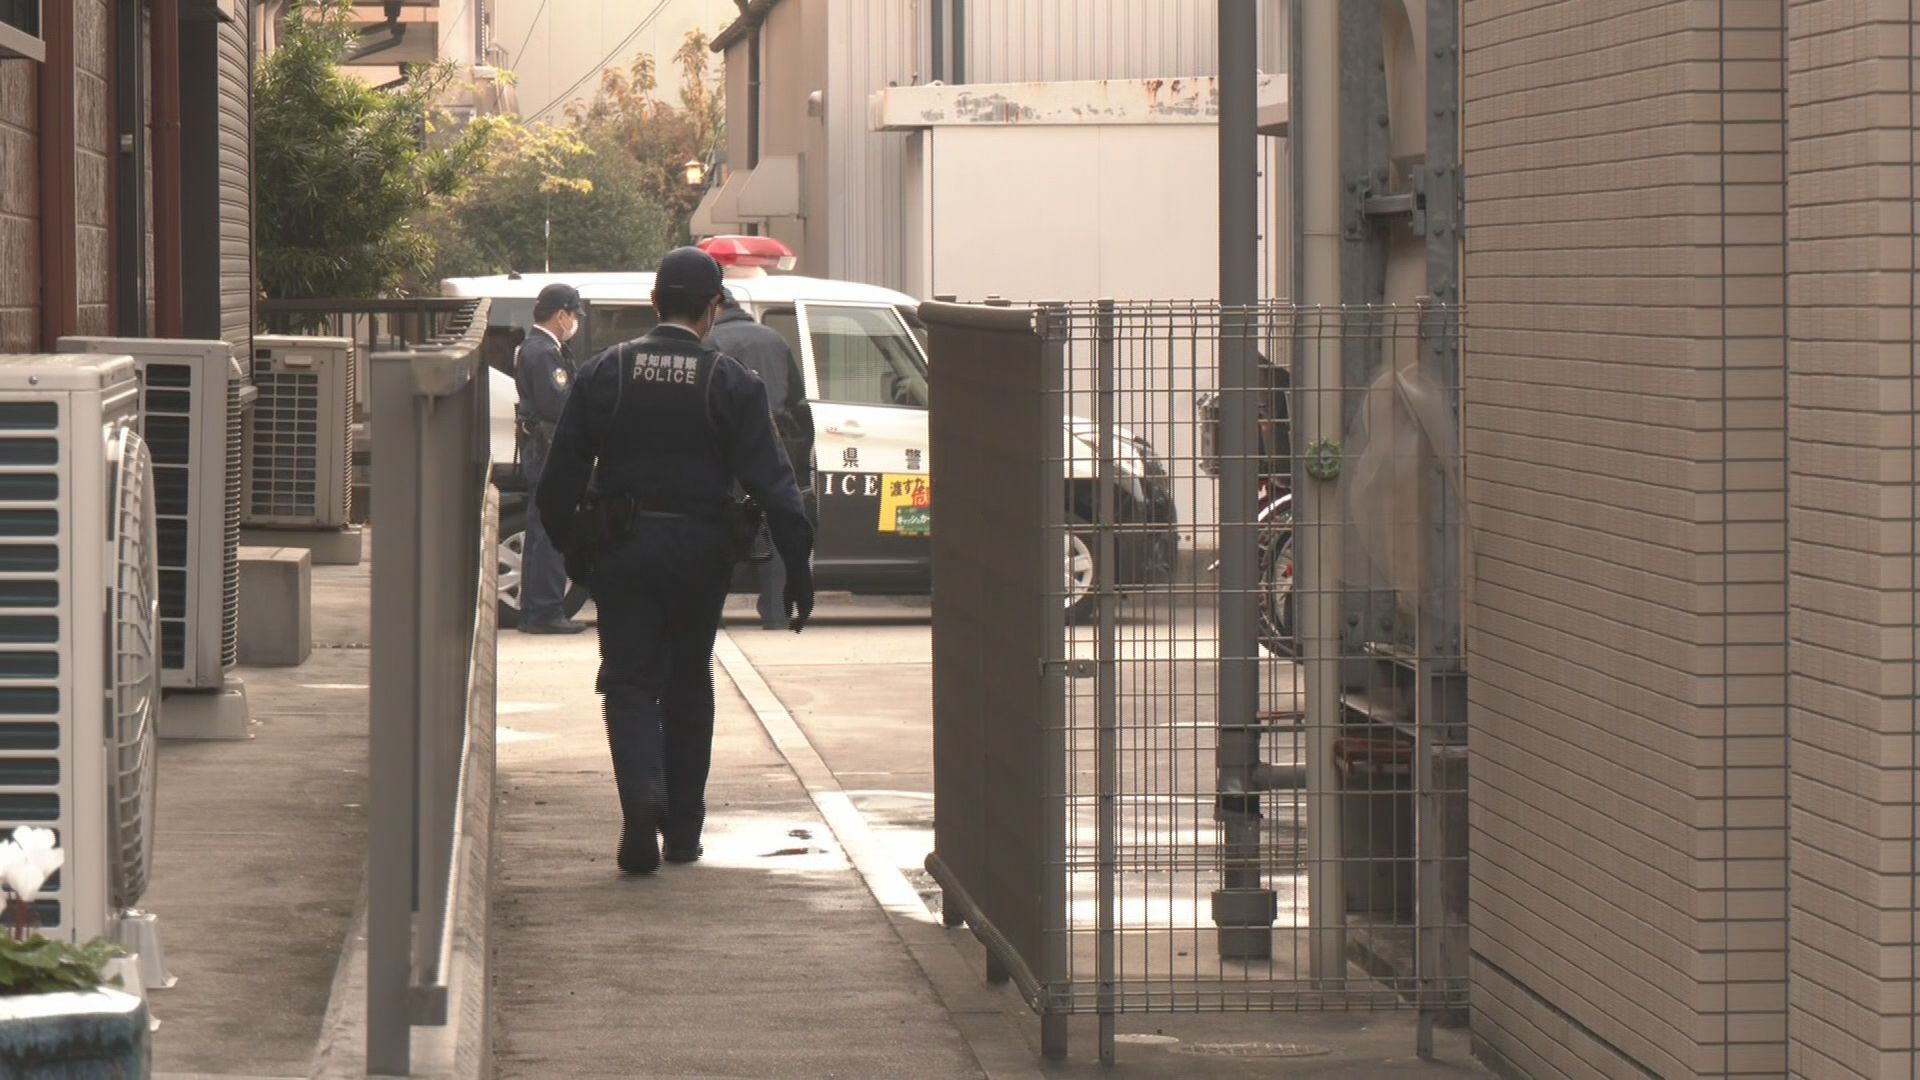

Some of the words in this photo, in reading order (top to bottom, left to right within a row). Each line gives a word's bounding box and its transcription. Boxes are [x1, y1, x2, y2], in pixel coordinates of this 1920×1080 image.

[635, 353, 697, 370] 愛知県警察
[633, 366, 696, 384] POLICE
